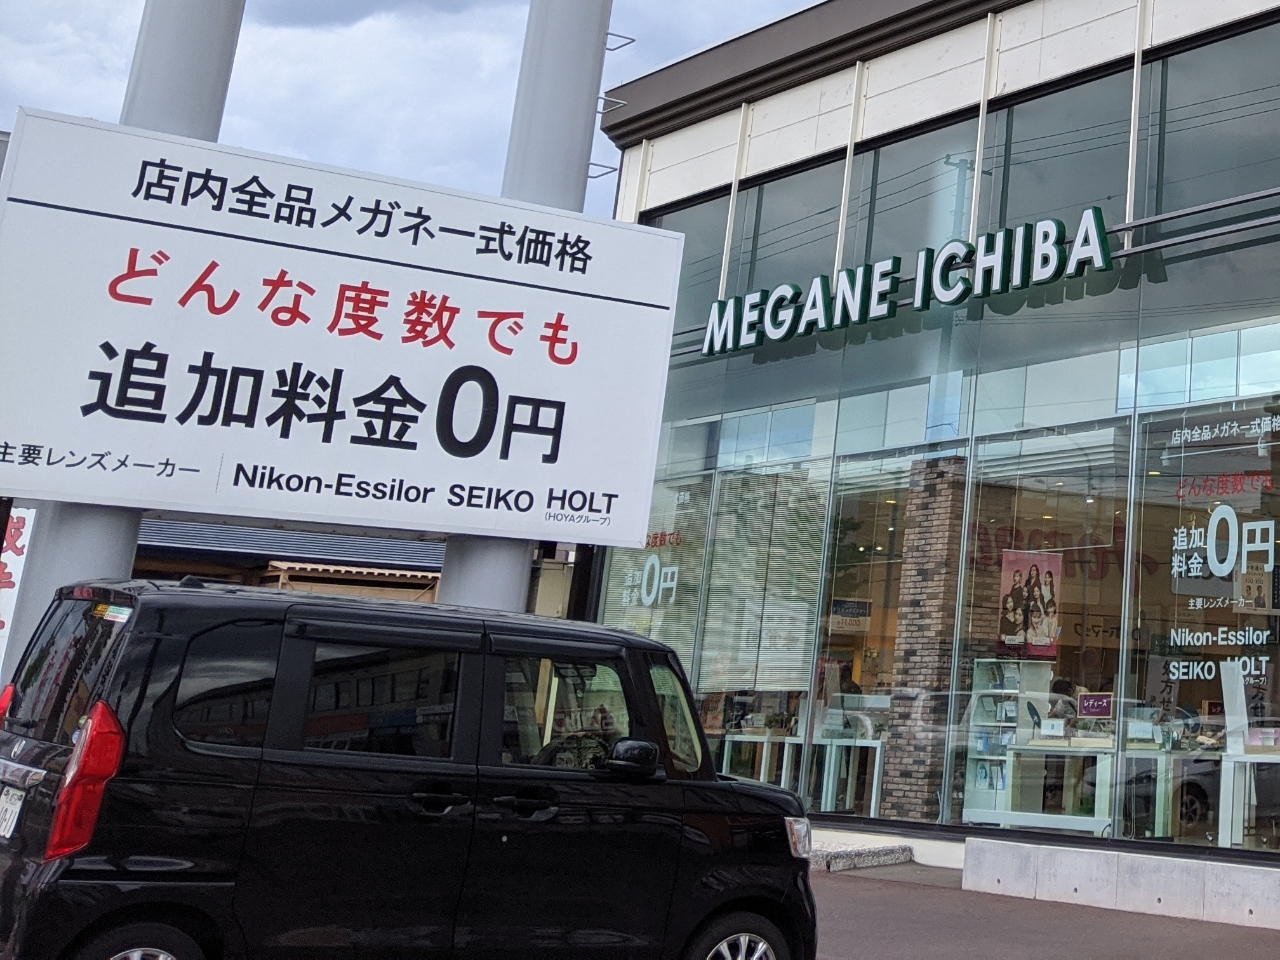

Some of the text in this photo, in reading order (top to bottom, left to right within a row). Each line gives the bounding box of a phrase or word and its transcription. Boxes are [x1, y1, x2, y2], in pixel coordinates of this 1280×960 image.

[131, 158, 594, 275] 店内全品メガネ一式価格
[106, 246, 581, 366] どんな度数でも
[701, 206, 1113, 356] MEGANE ICHIBA
[80, 340, 567, 466] 追加料金0円
[0, 441, 201, 478] 主要レンズメーカー
[1175, 469, 1277, 500] どんな度数でも
[232, 462, 619, 515] Nikon-Essilor SEIKO HOLT
[1170, 626, 1271, 647] Nikon-Essilor
[1169, 660, 1216, 681] SEIKO
